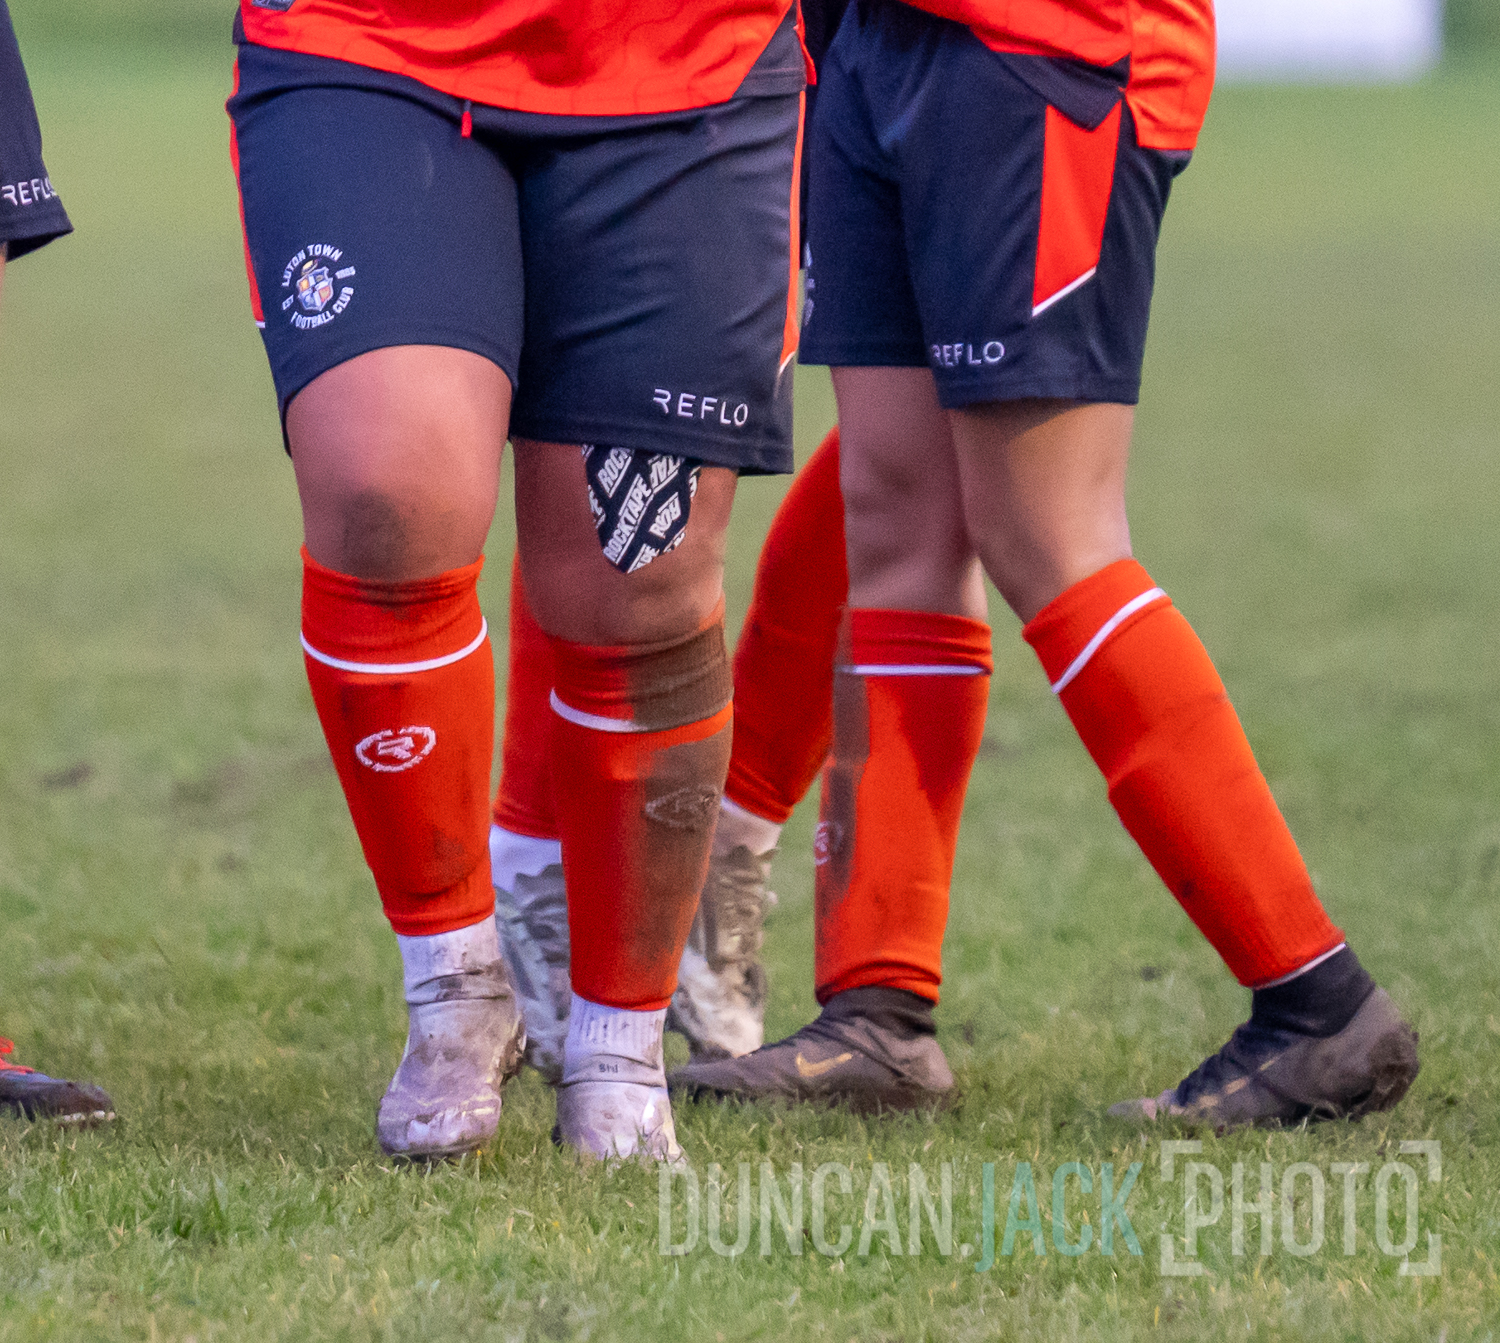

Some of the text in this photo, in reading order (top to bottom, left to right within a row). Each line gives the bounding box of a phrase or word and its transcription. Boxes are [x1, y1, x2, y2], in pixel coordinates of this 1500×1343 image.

[281, 243, 343, 287] LUTON TOWN
[290, 286, 355, 329] FOOTBALL CLUB
[930, 340, 1006, 366] REFLO
[653, 388, 749, 427] REFLO
[602, 476, 653, 563] ROCKTAPE
